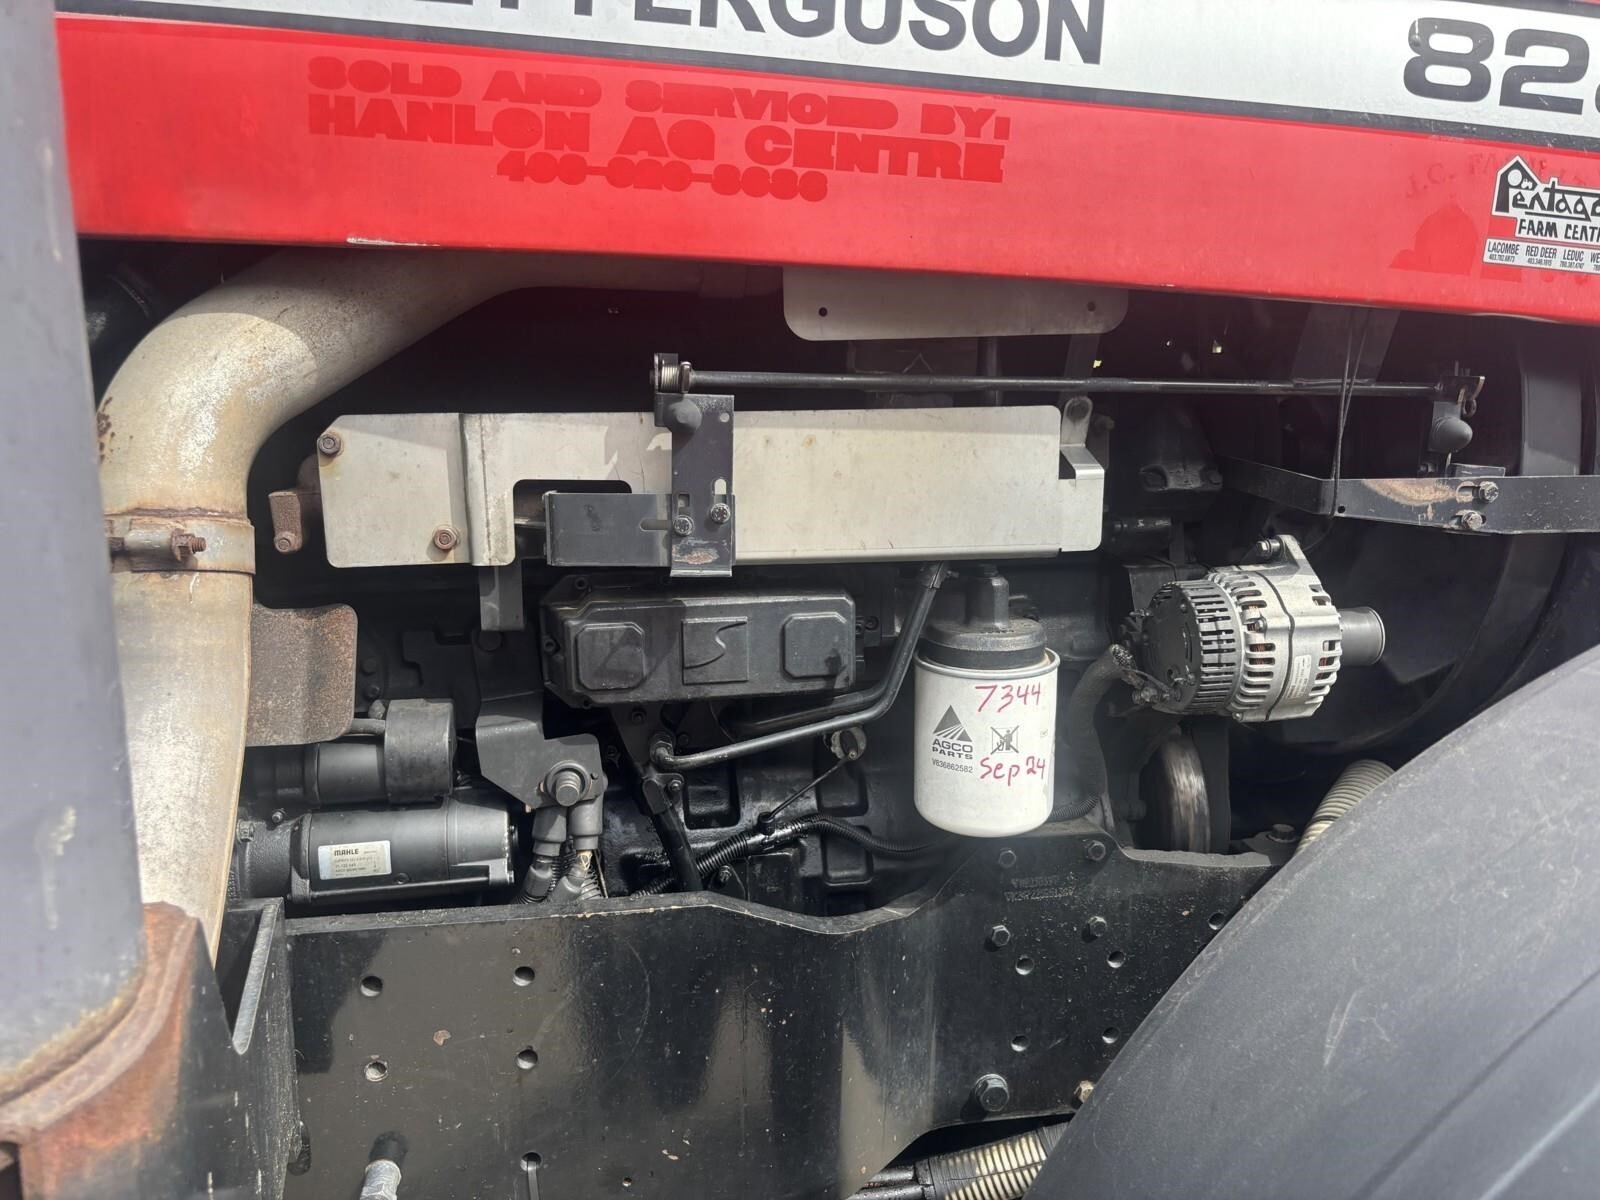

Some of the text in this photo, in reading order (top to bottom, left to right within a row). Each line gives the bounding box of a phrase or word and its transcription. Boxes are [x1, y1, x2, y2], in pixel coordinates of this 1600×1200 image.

[1403, 17, 1600, 115] 82
[308, 56, 462, 98] SOLD
[482, 70, 602, 107] AND
[308, 94, 591, 152] HANLON
[745, 125, 1005, 182] CENTRE
[1518, 219, 1600, 243] FARM CENT
[1488, 241, 1520, 255] LACOMBE
[1525, 245, 1539, 257] RED
[1540, 247, 1557, 259] DEER
[1563, 249, 1584, 262] LEDUC
[975, 682, 1041, 713] 7344
[932, 738, 973, 753] AGCO
[932, 746, 973, 759] PARTS
[980, 756, 1046, 786] Sep 24
[334, 848, 359, 856] MAHLE
